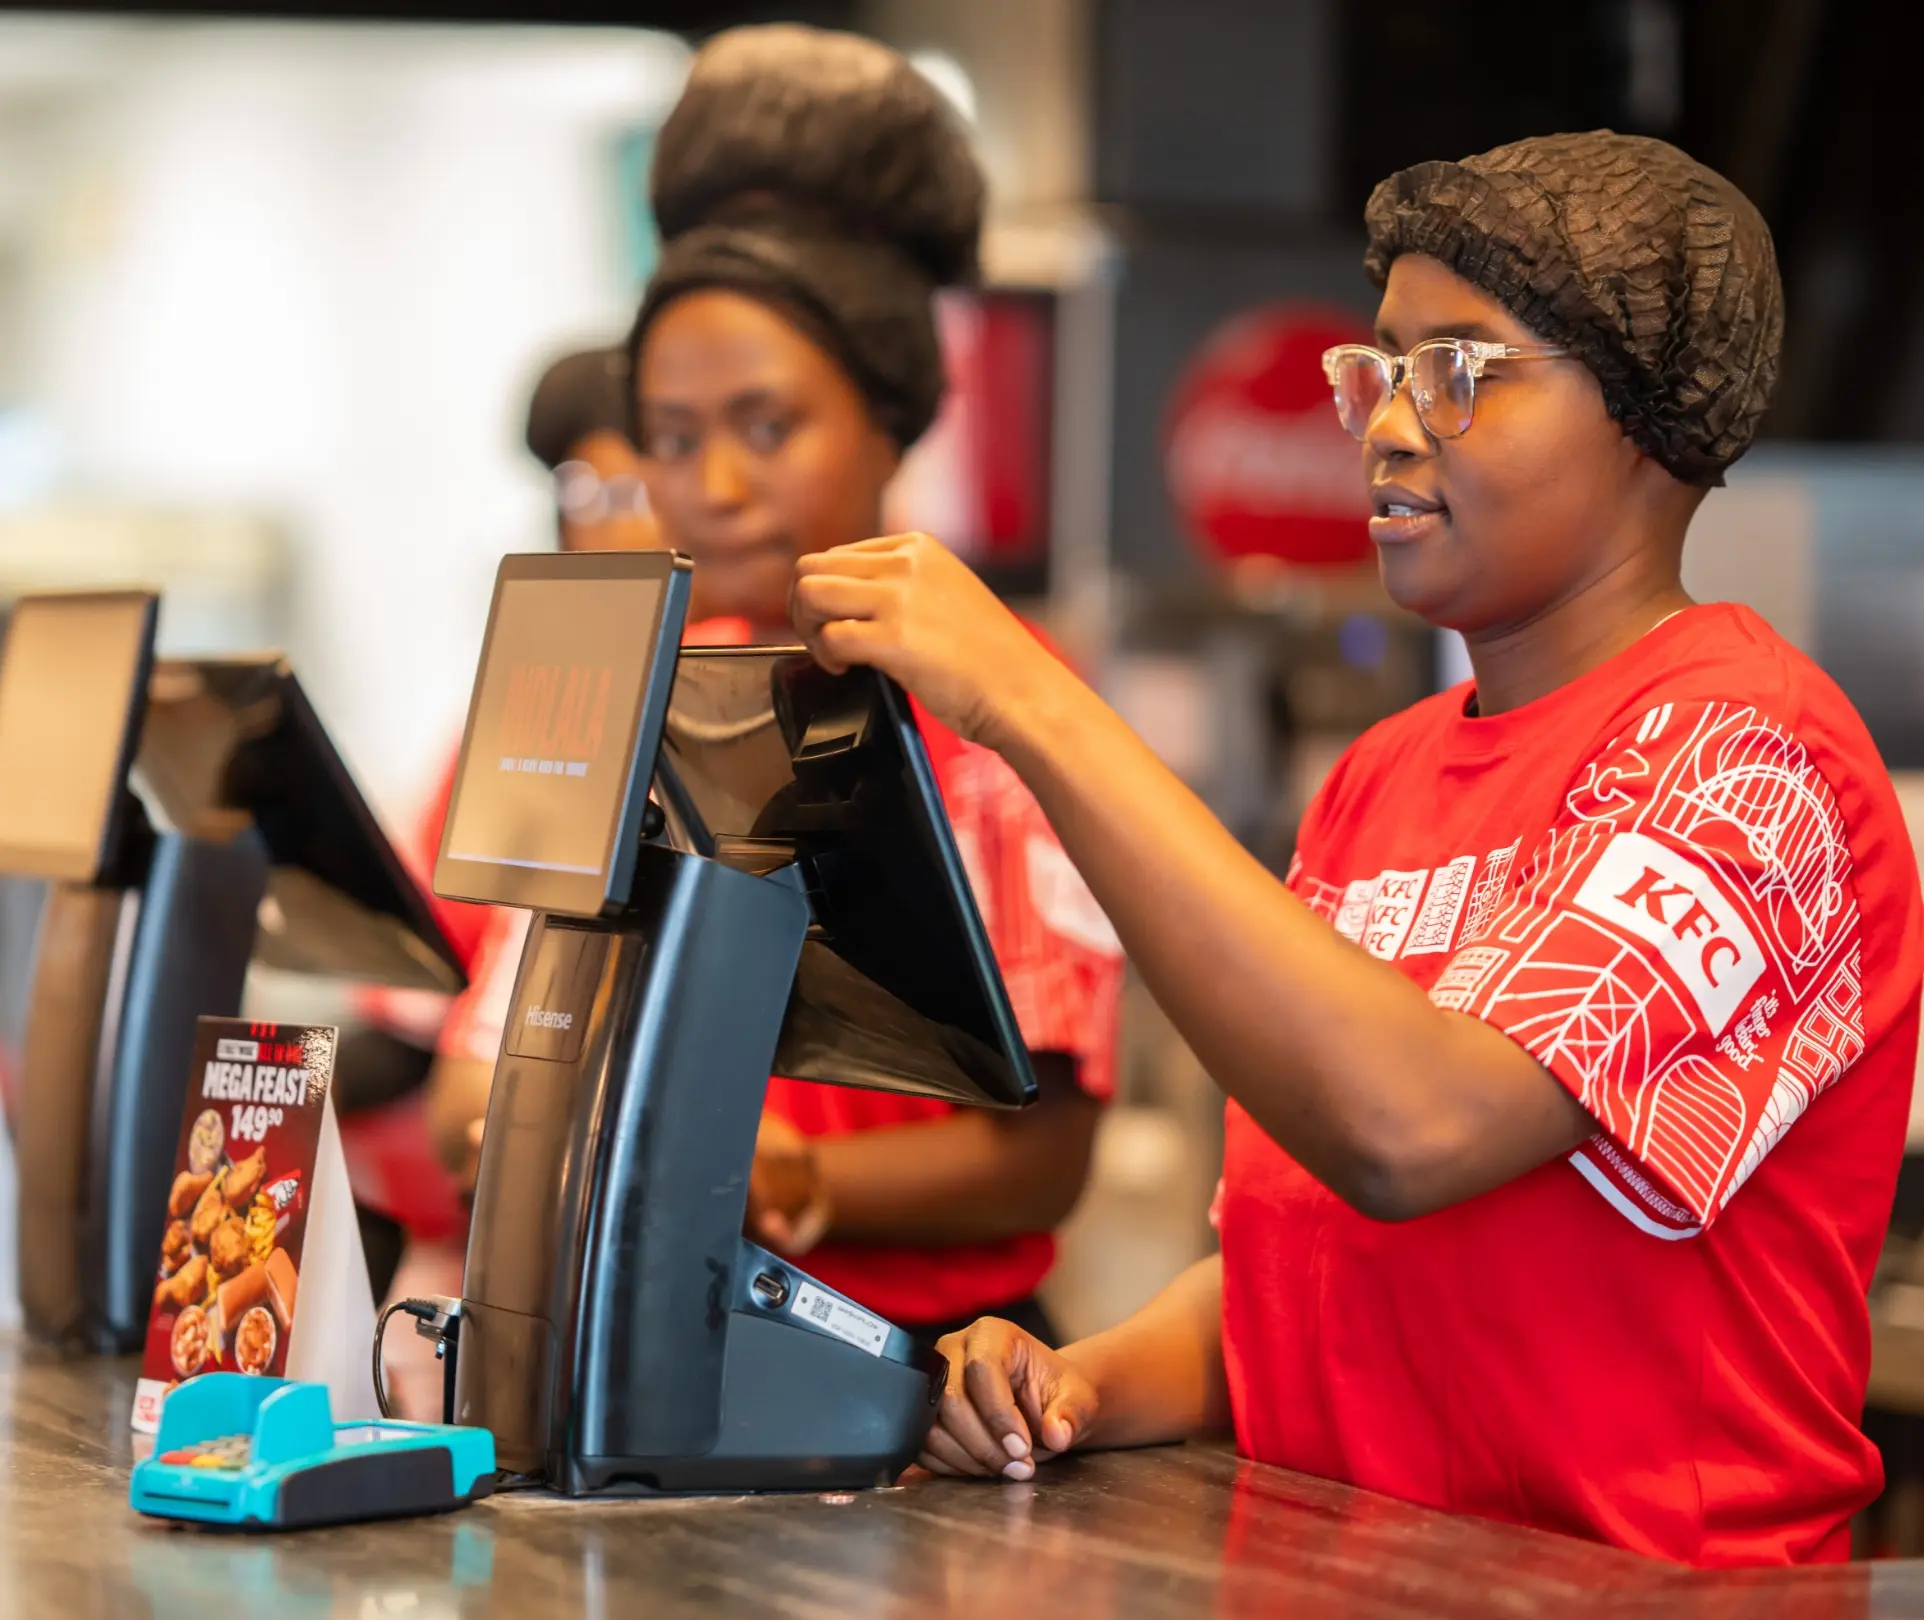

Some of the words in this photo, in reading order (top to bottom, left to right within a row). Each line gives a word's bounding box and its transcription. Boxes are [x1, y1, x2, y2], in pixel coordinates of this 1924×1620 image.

[1377, 878, 1419, 900] KFC
[1613, 865, 1742, 989] KFC
[525, 1004, 573, 1030] Hisense
[1715, 1034, 1765, 1072] good
